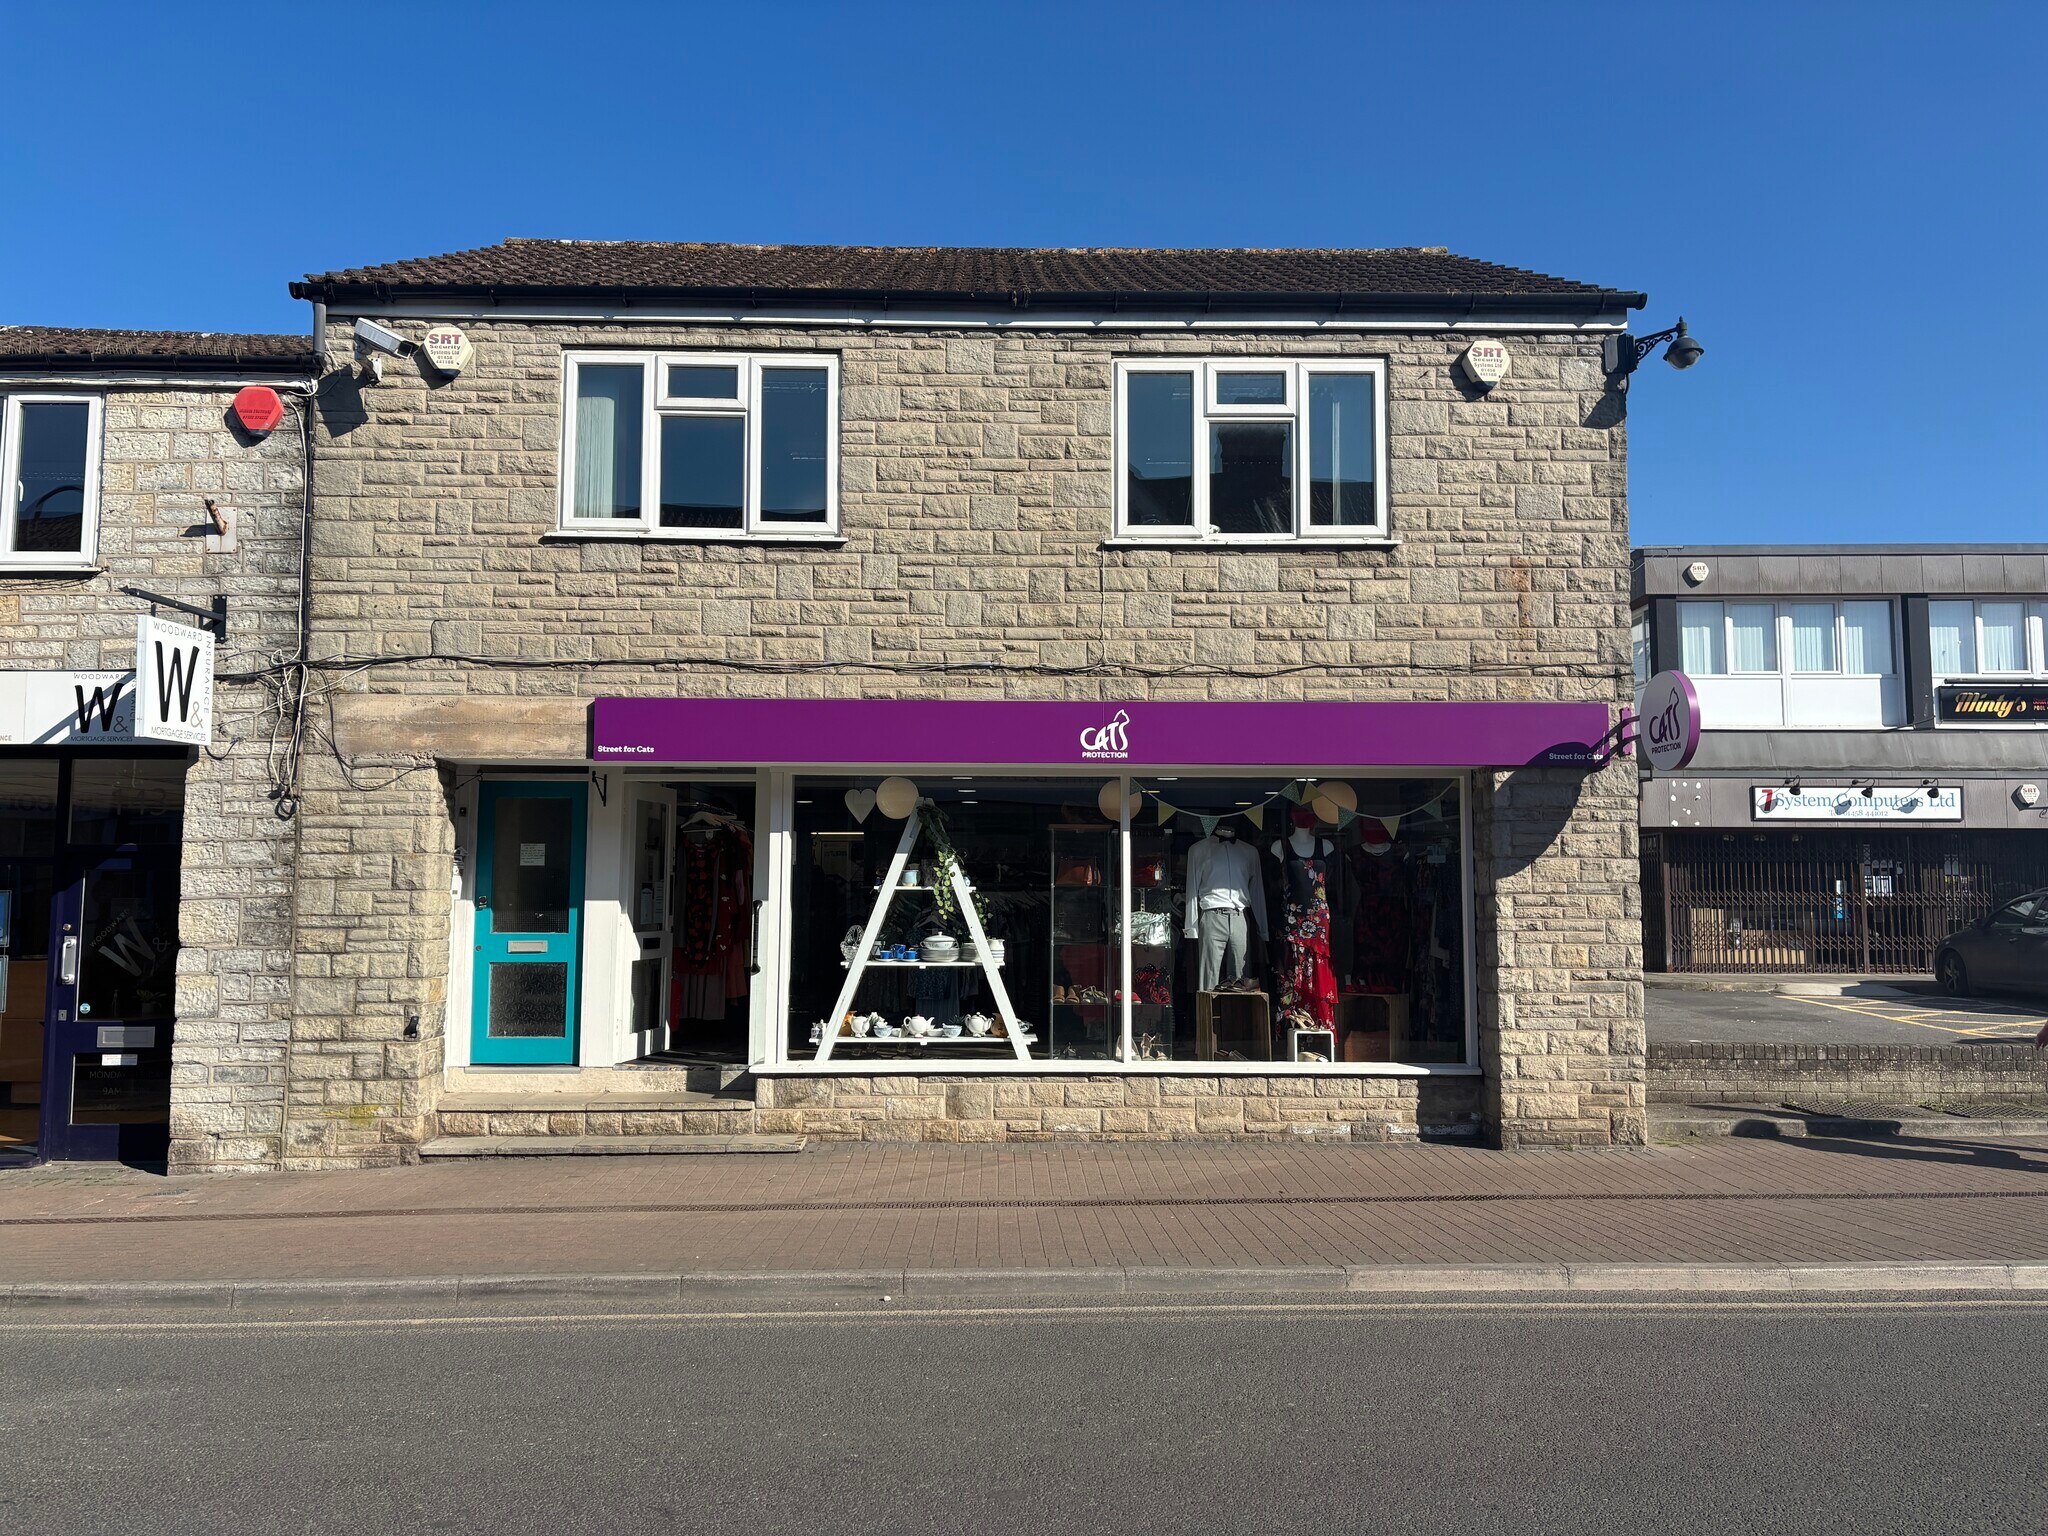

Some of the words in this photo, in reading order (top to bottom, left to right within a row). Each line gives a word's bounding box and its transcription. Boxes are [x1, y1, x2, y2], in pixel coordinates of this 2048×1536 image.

[429, 334, 462, 345] SRT
[1472, 347, 1504, 358] SRT
[153, 621, 203, 641] WOODWARD
[74, 672, 126, 680] WOODWARD
[155, 640, 200, 723] W
[203, 635, 212, 714] INSURANCE
[75, 683, 125, 733] W
[1955, 692, 2027, 718] Minty's
[113, 715, 129, 733] &
[190, 701, 204, 729] &
[1649, 687, 1680, 744] CATS
[151, 726, 183, 739] MORTGAGE
[184, 730, 207, 742] SERVICES
[1080, 709, 1130, 751] CATS
[597, 745, 622, 753] Street
[623, 745, 636, 753] for
[637, 745, 655, 753] Cats
[1549, 752, 1574, 760] Street
[1574, 752, 1586, 760] for
[1586, 752, 1604, 760] Cats
[1651, 742, 1681, 755] PROTECTION
[1776, 793, 1830, 811] System
[1836, 793, 1924, 812] Computers
[1928, 793, 1956, 808] Ltd
[89, 1071, 128, 1080] MONDAY
[102, 1087, 122, 1096] 9AM
